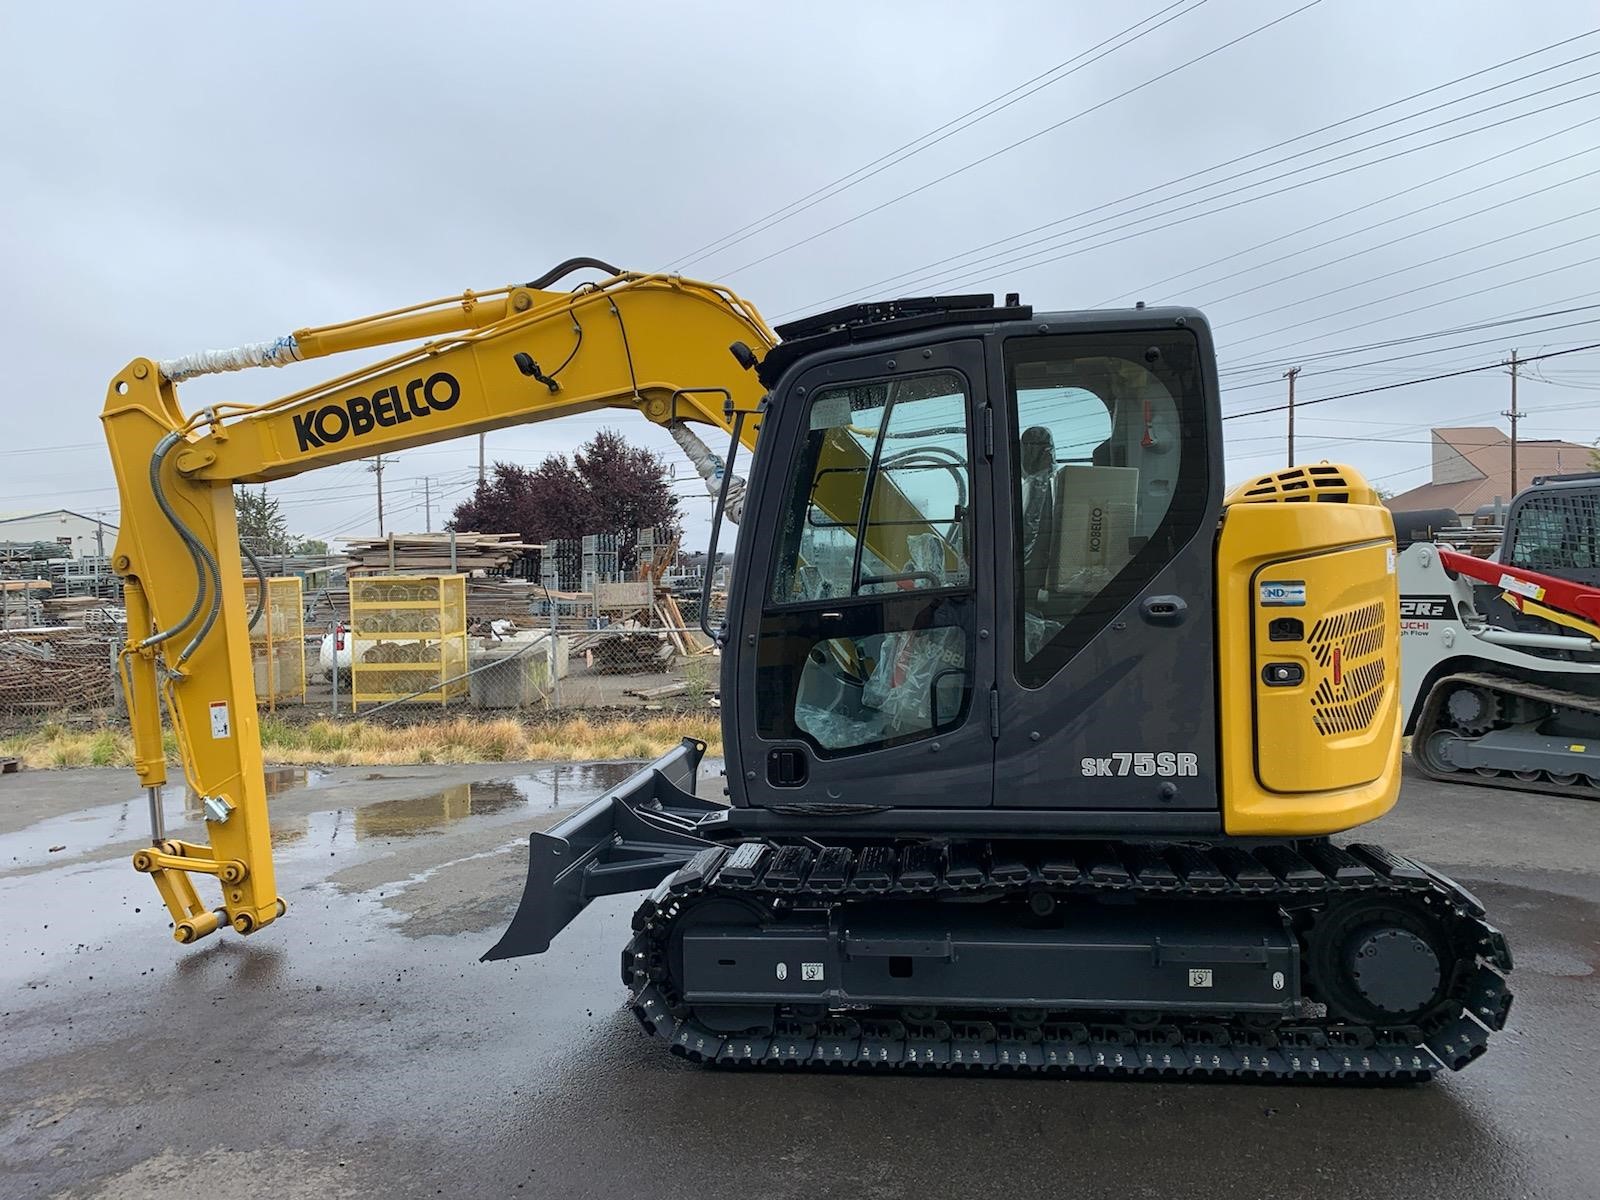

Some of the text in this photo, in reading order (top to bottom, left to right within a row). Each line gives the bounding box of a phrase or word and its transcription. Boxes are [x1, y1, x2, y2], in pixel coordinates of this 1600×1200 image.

[292, 372, 461, 452] KOBELCO
[1089, 507, 1102, 553] KOBELCO
[1081, 752, 1198, 777] SK75SR
